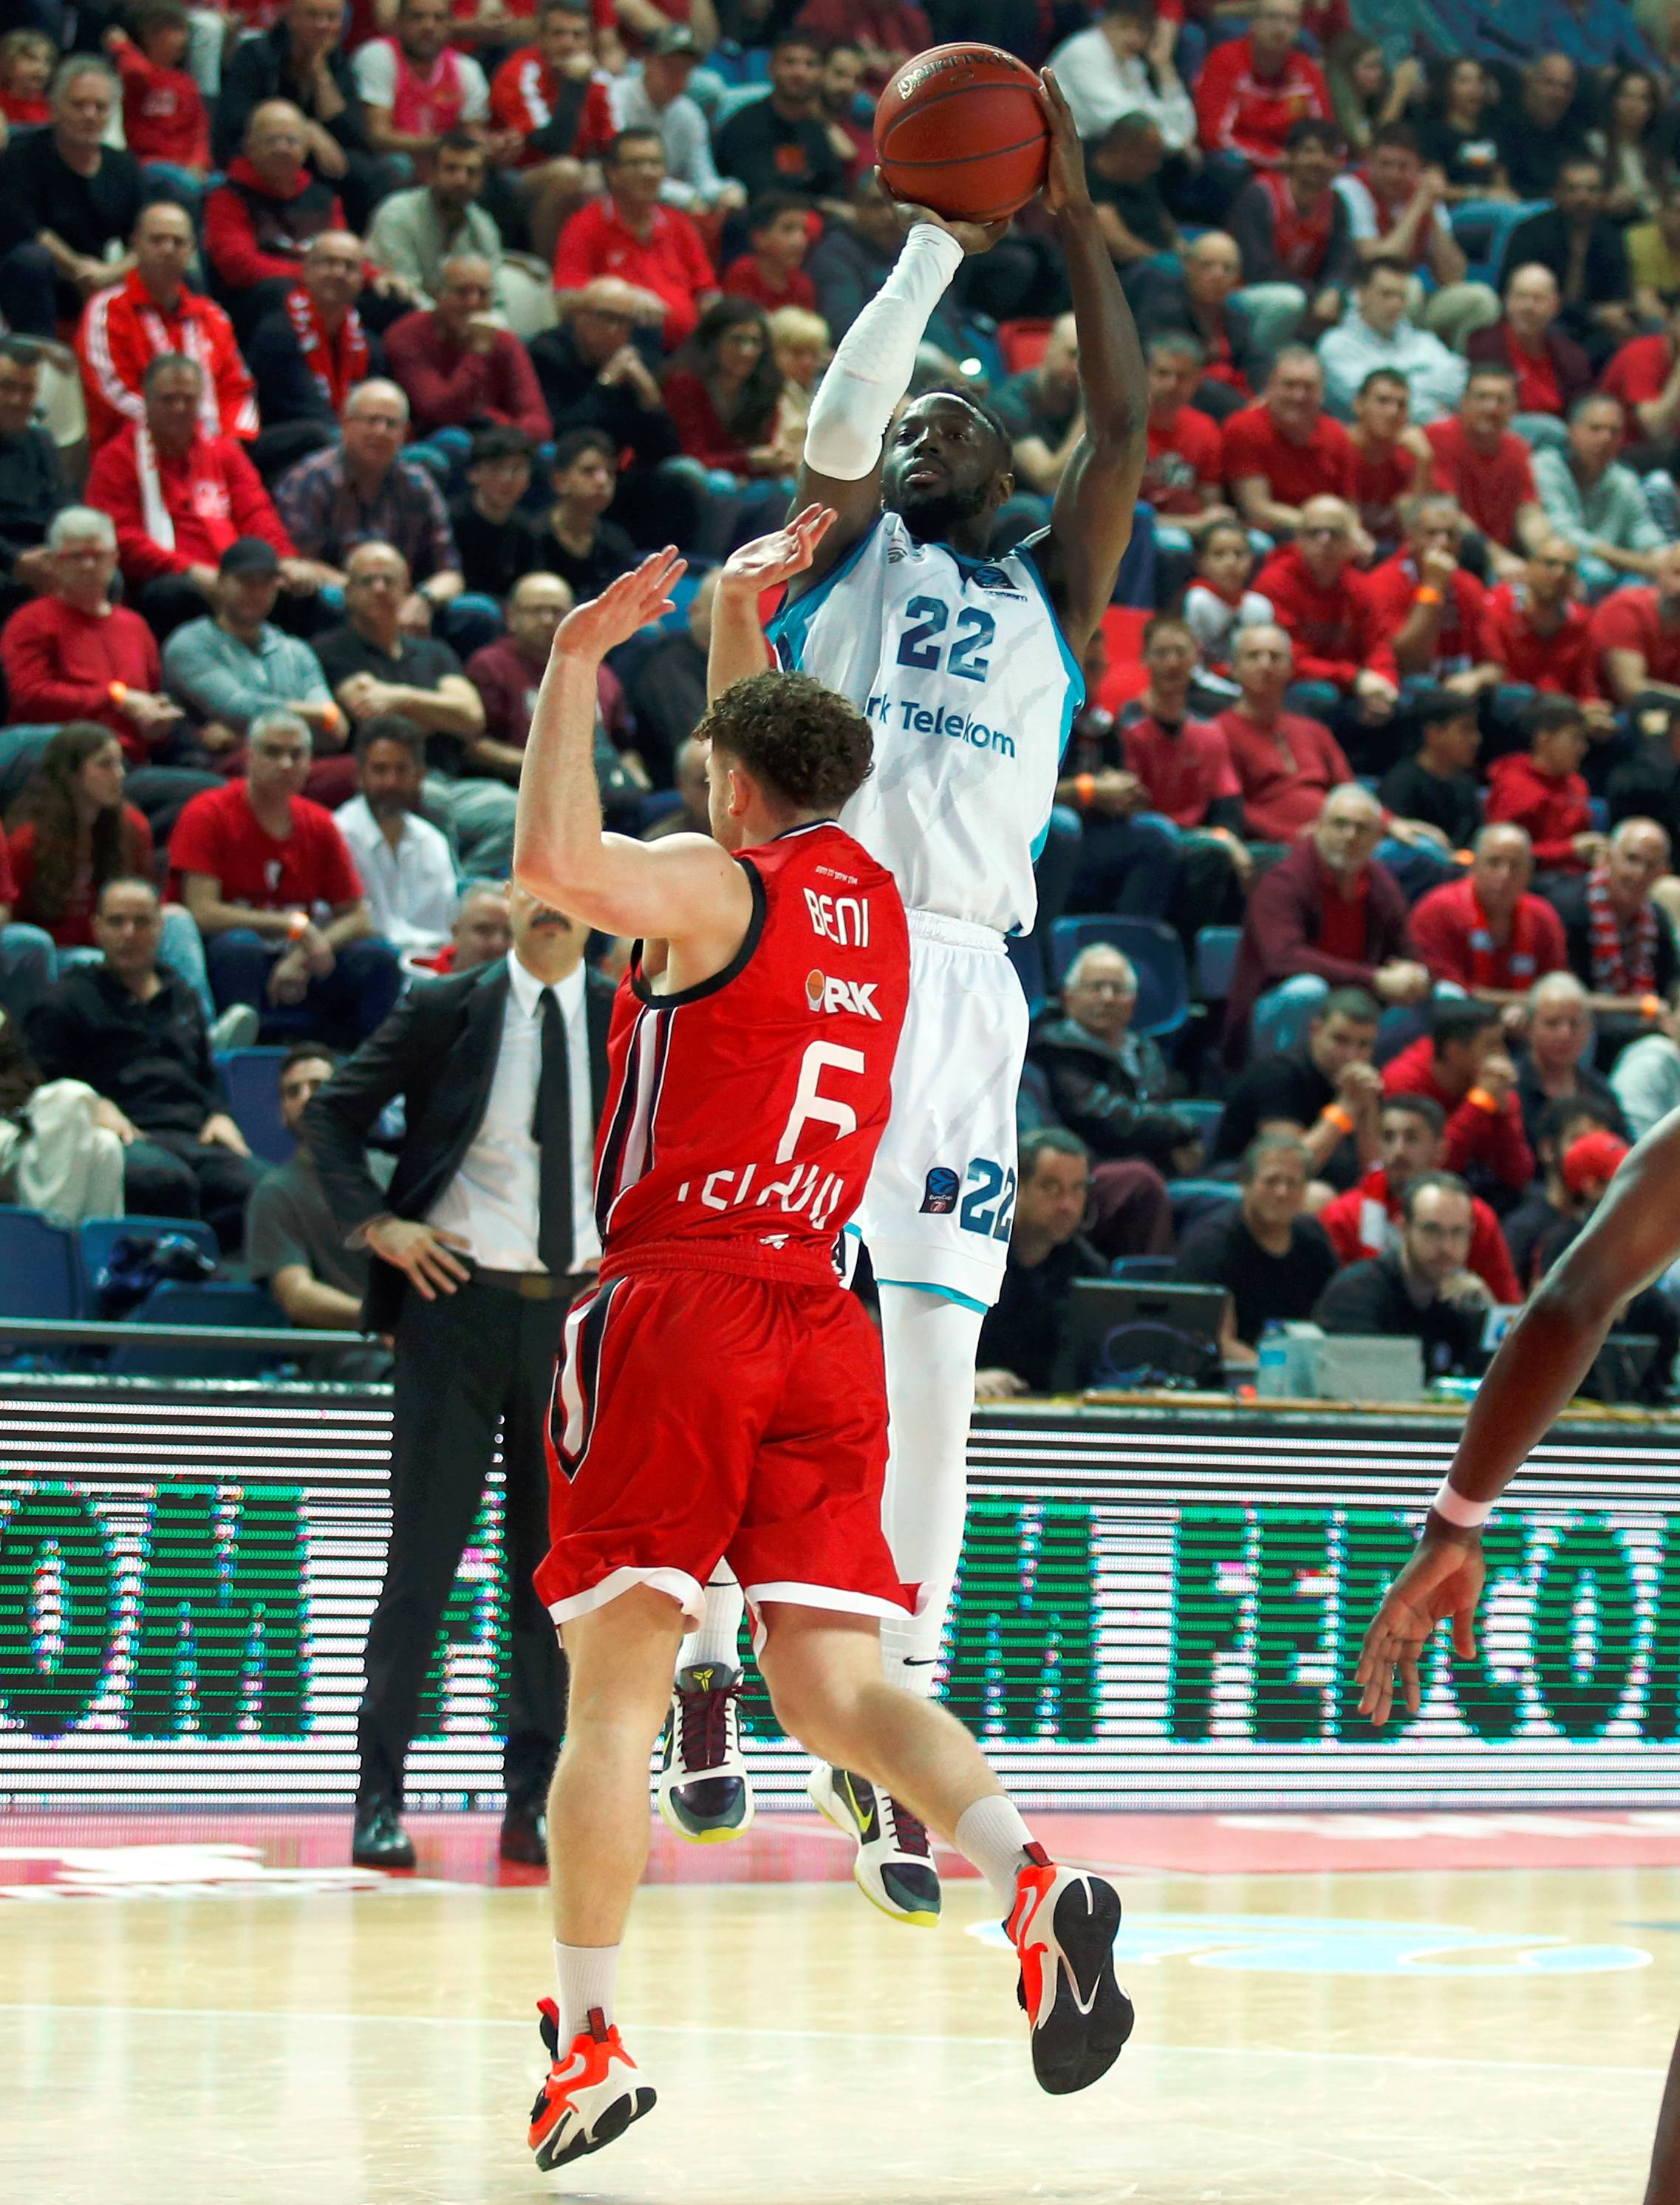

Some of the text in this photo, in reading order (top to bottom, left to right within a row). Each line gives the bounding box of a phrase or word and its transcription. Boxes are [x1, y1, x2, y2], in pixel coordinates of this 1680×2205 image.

[896, 595, 996, 683] 22
[901, 701, 1016, 759] Telekom
[803, 887, 869, 948] BENI
[960, 1158, 1017, 1243] 22
[1166, 1502, 1680, 1741] FEDCO
